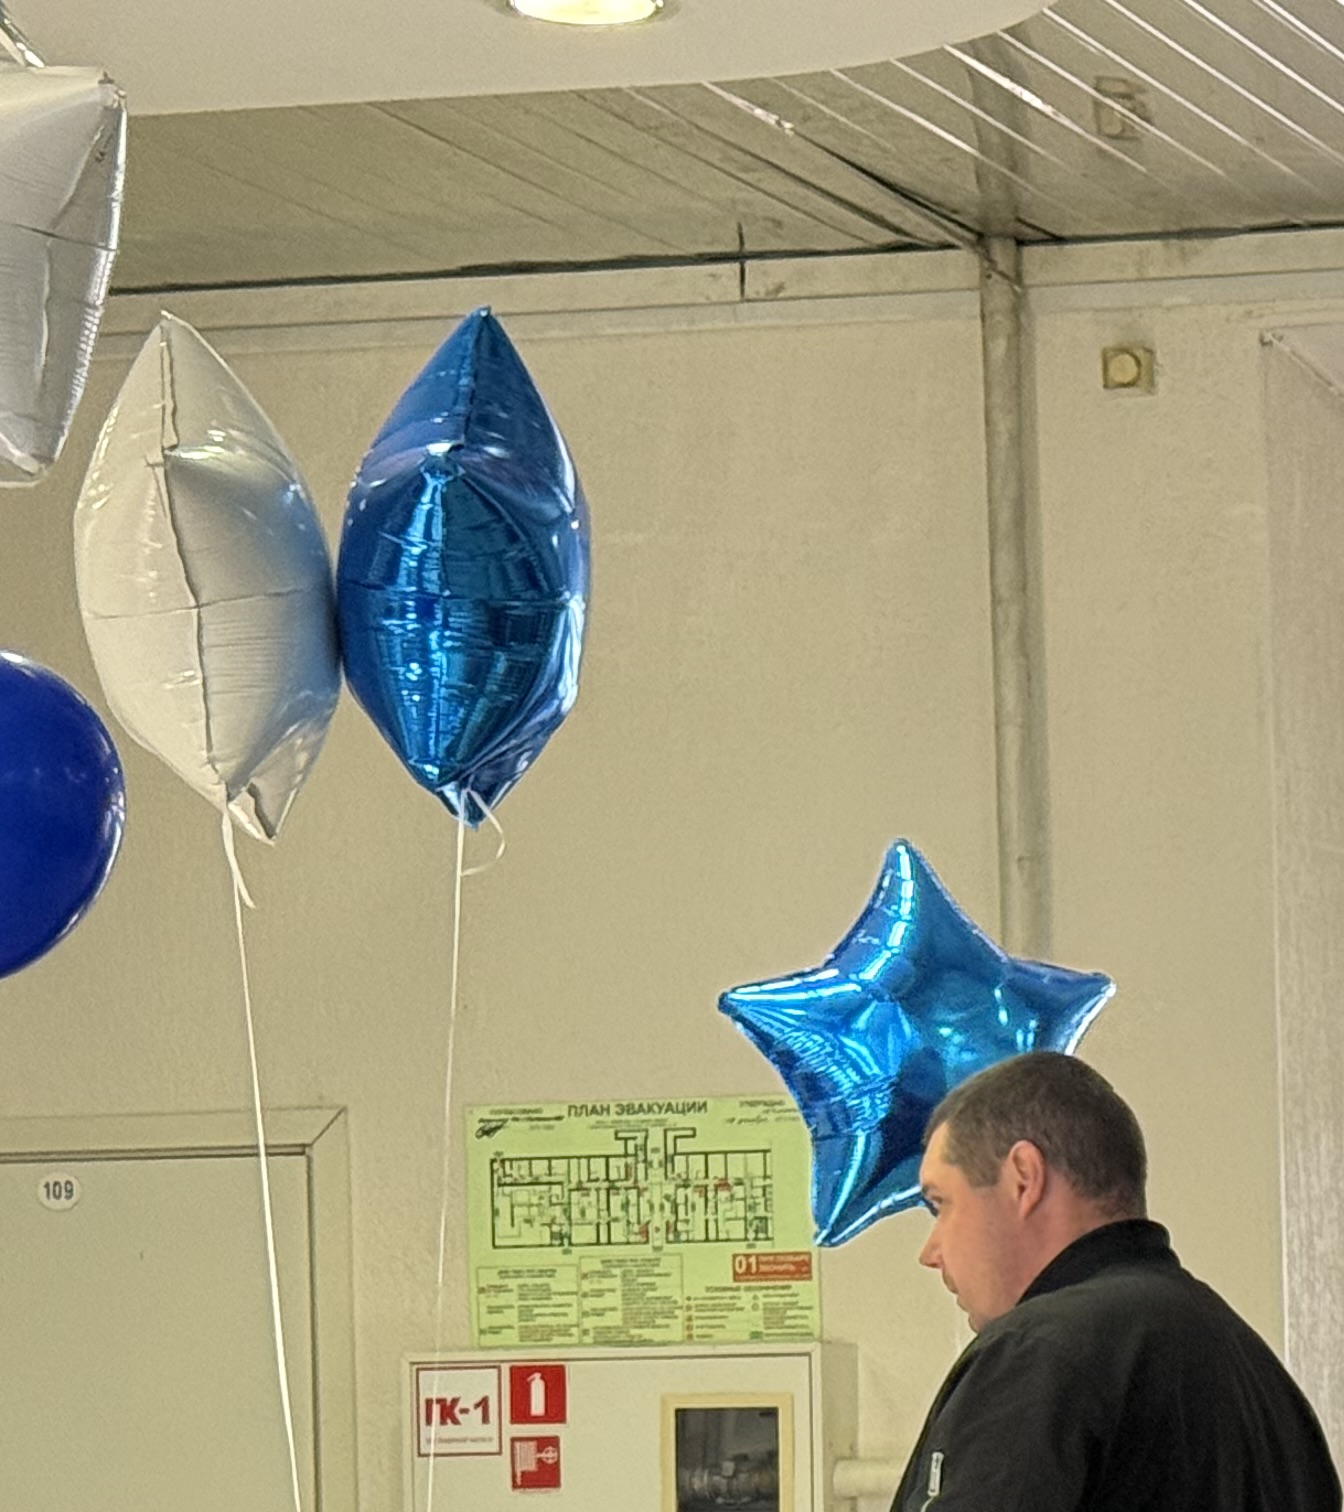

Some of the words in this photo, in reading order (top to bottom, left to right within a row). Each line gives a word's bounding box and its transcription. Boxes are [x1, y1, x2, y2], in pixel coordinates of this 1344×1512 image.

[567, 1102, 610, 1118] ПЛАН
[614, 1100, 708, 1118] ЭВАКУАЦИИ
[43, 1179, 74, 1200] 109
[735, 1255, 757, 1274] 01
